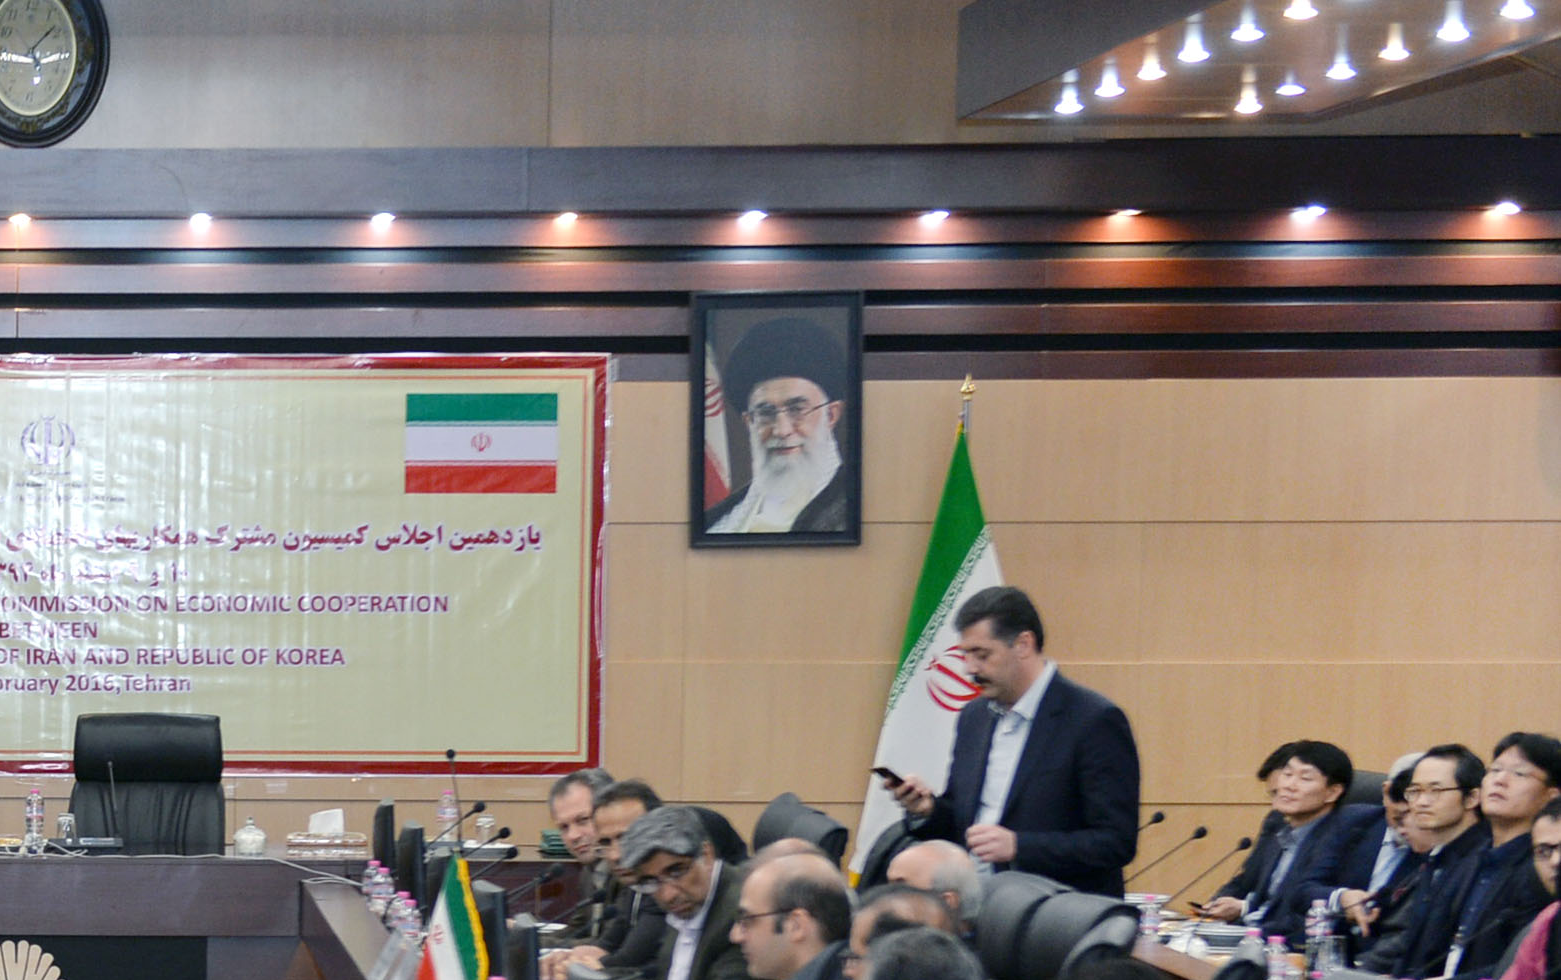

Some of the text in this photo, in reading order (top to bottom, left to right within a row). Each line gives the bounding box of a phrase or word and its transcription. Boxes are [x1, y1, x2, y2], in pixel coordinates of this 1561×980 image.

[282, 524, 370, 551] کمیسیون
[375, 524, 444, 551] اجلاس
[448, 524, 542, 551] یازدهمین
[136, 595, 169, 613] ON
[175, 595, 291, 613] ECONOMIC
[297, 595, 449, 613] COOPERATION
[25, 648, 77, 666] IRAN
[83, 648, 131, 666] AND
[136, 648, 235, 666] REPUBLIC
[241, 648, 270, 666] OF
[275, 648, 346, 666] KOREA
